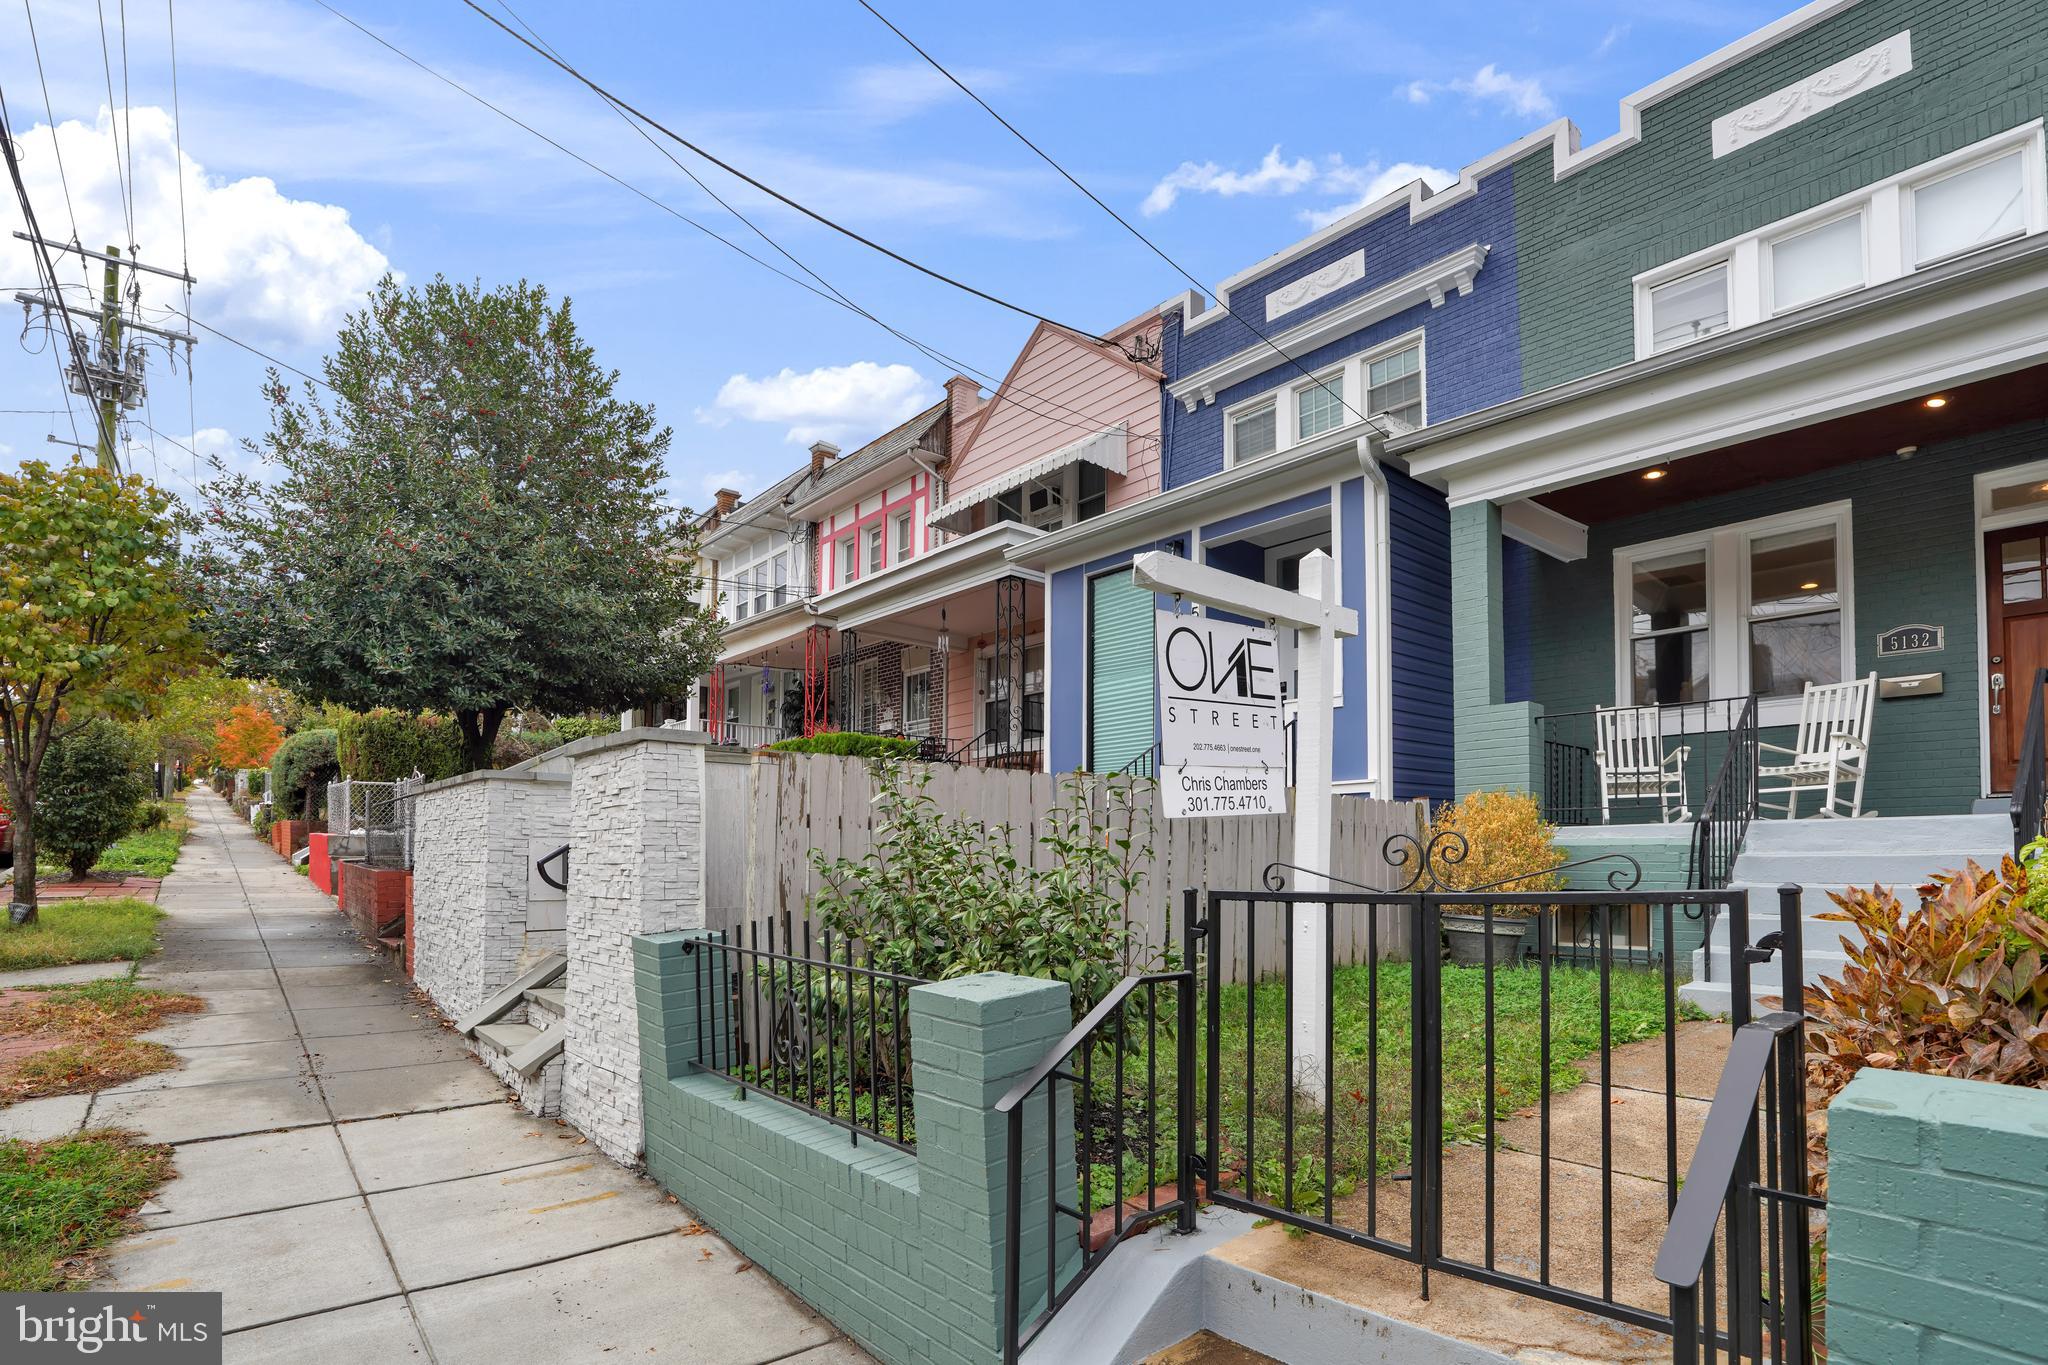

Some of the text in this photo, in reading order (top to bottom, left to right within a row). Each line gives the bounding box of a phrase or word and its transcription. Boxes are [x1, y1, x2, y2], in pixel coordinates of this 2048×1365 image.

[1891, 632, 1930, 650] 5132
[1165, 626, 1276, 701] ONE
[1168, 706, 1277, 730] STREET
[1193, 742, 1261, 753] 202.775.4663 onestreet.one
[1181, 775, 1268, 792] Chris Chambers
[1187, 795, 1267, 812] 301.775.4710
